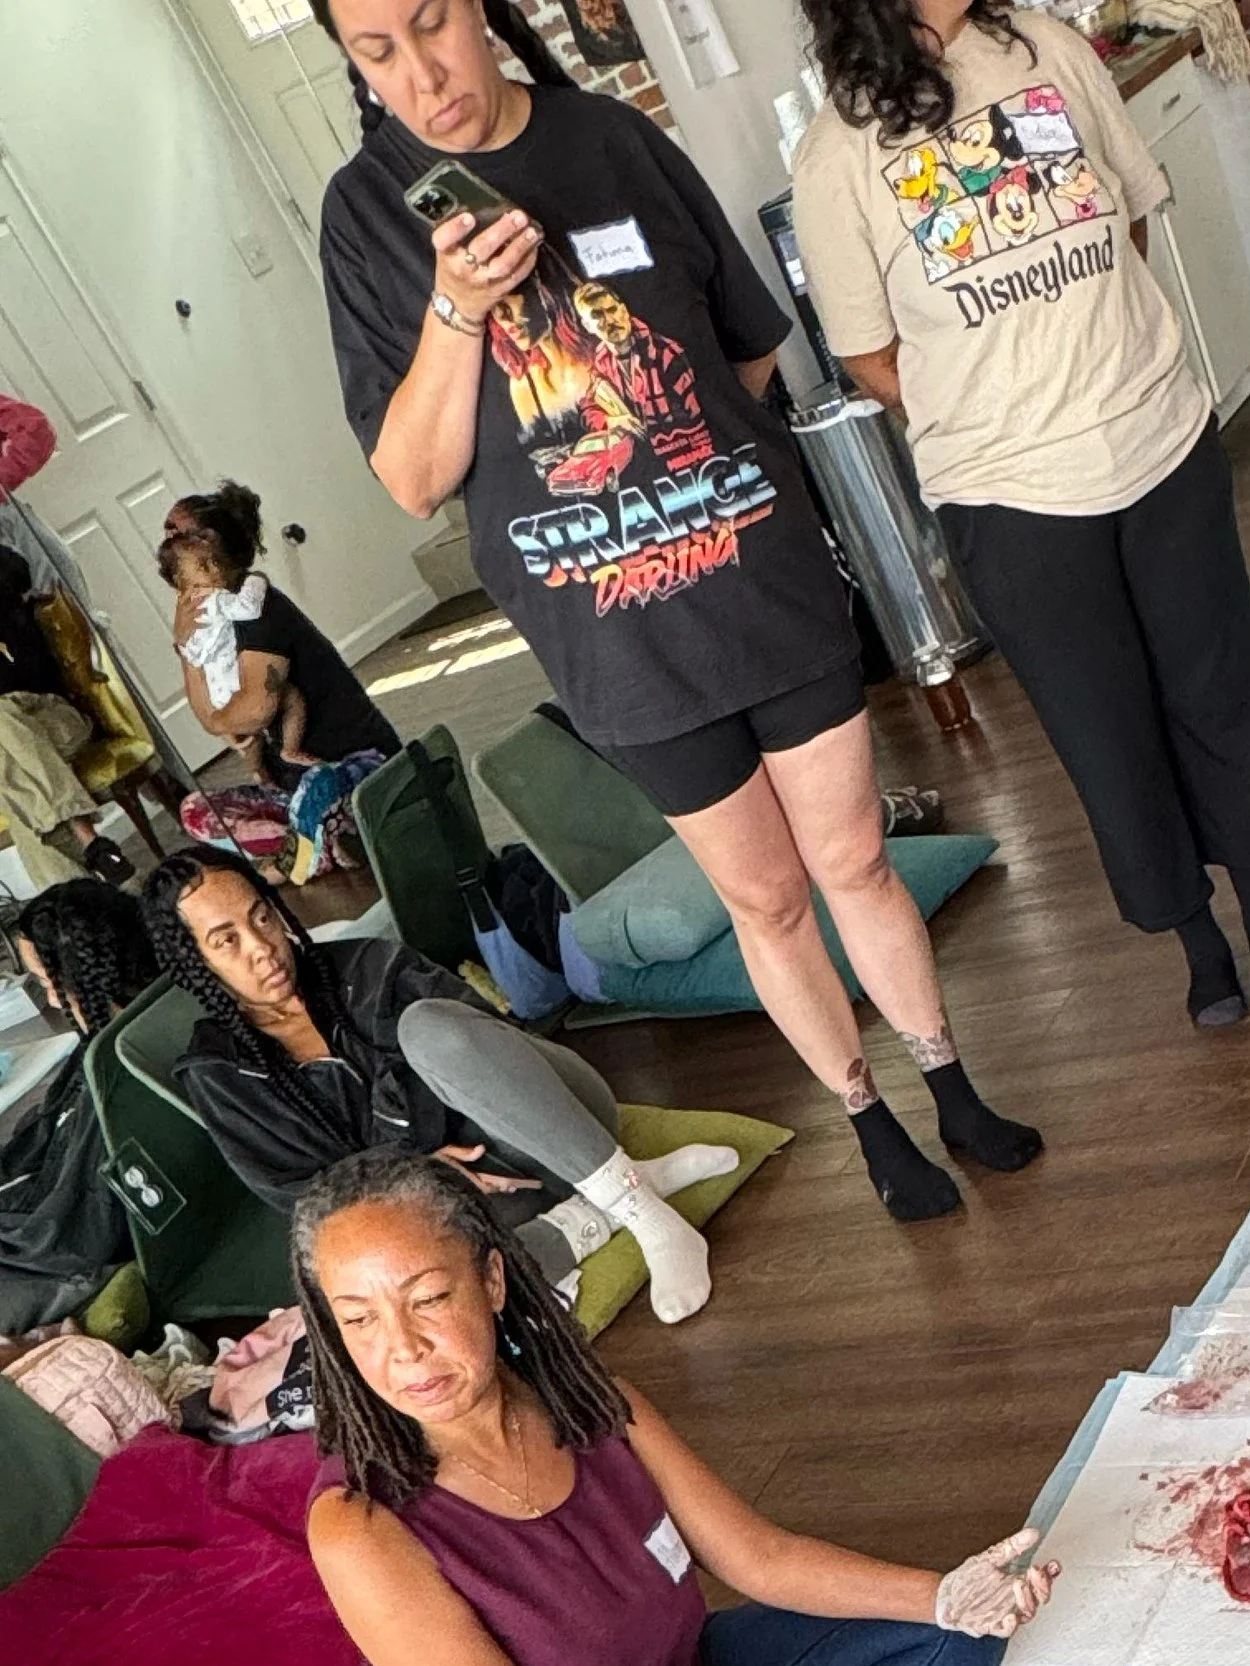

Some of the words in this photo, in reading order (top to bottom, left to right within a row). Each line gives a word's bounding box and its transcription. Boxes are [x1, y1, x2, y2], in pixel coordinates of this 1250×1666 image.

[942, 225, 1115, 330] Disneyland
[508, 442, 778, 576] STRANGE
[277, 1387, 303, 1409] She
